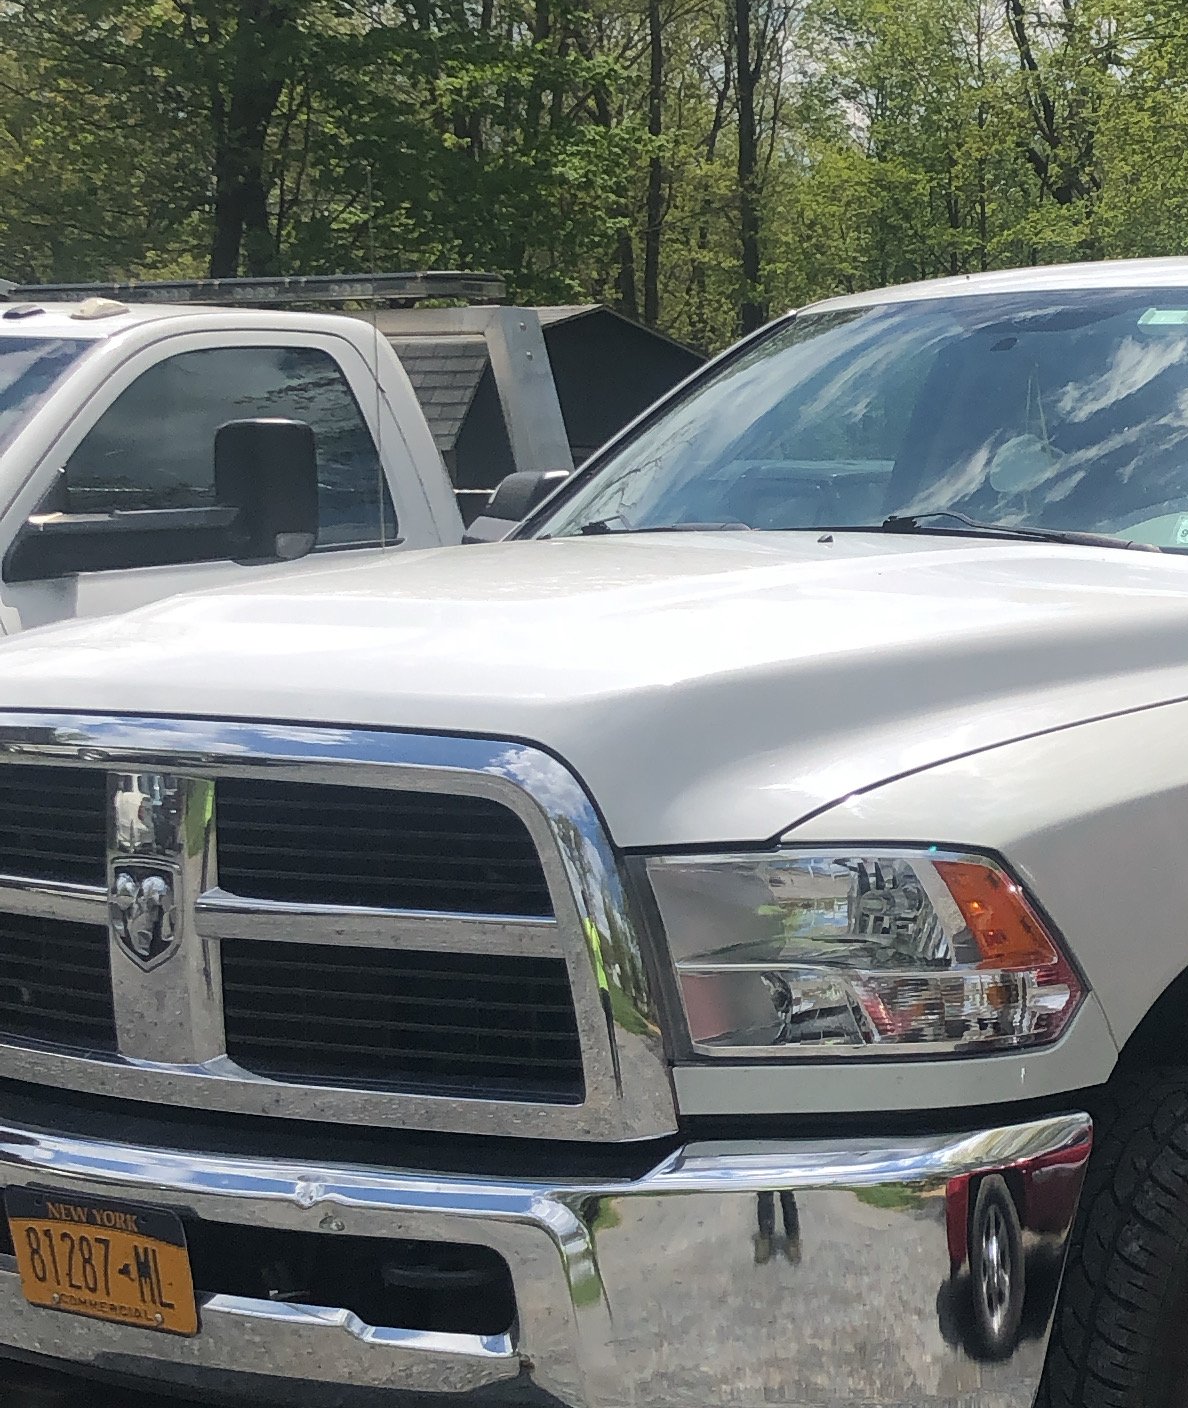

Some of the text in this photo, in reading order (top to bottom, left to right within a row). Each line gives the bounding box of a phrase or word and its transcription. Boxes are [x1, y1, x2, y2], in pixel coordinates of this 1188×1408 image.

[46, 1201, 139, 1232] NEW YORK
[25, 1226, 111, 1297] 81287
